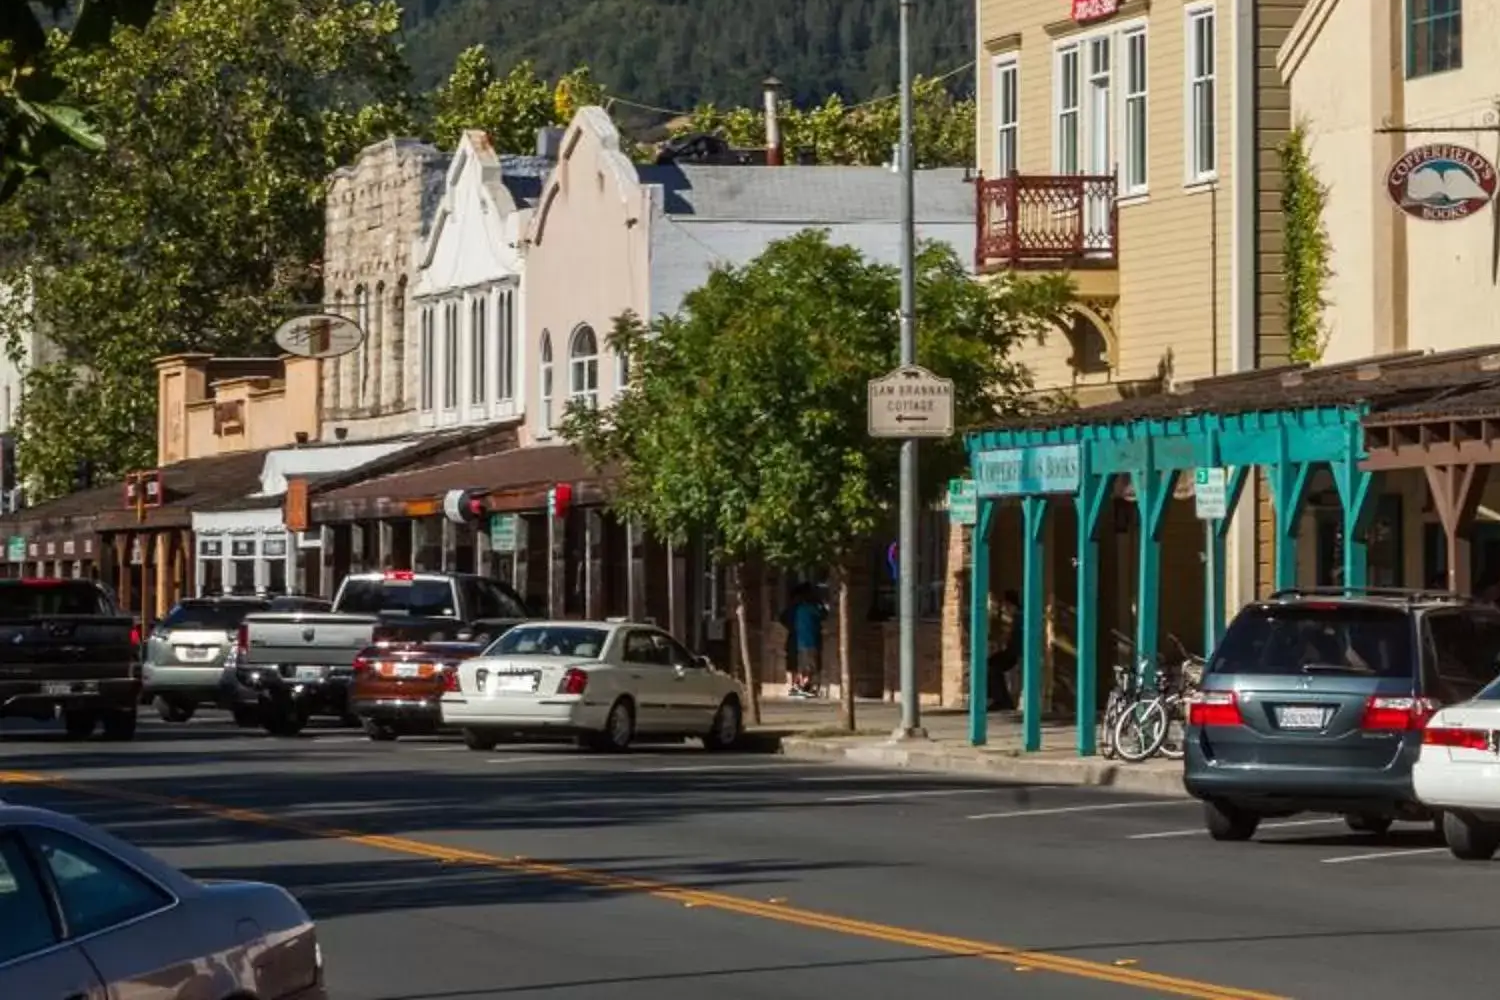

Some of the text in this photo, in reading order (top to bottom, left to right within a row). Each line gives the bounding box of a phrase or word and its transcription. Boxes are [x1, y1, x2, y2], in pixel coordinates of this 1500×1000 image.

[1391, 145, 1493, 185] COPPERFIELD'S
[1423, 206, 1468, 219] BOOKS
[873, 385, 950, 396] SAM BRANNAN
[887, 400, 934, 412] COTTAGE
